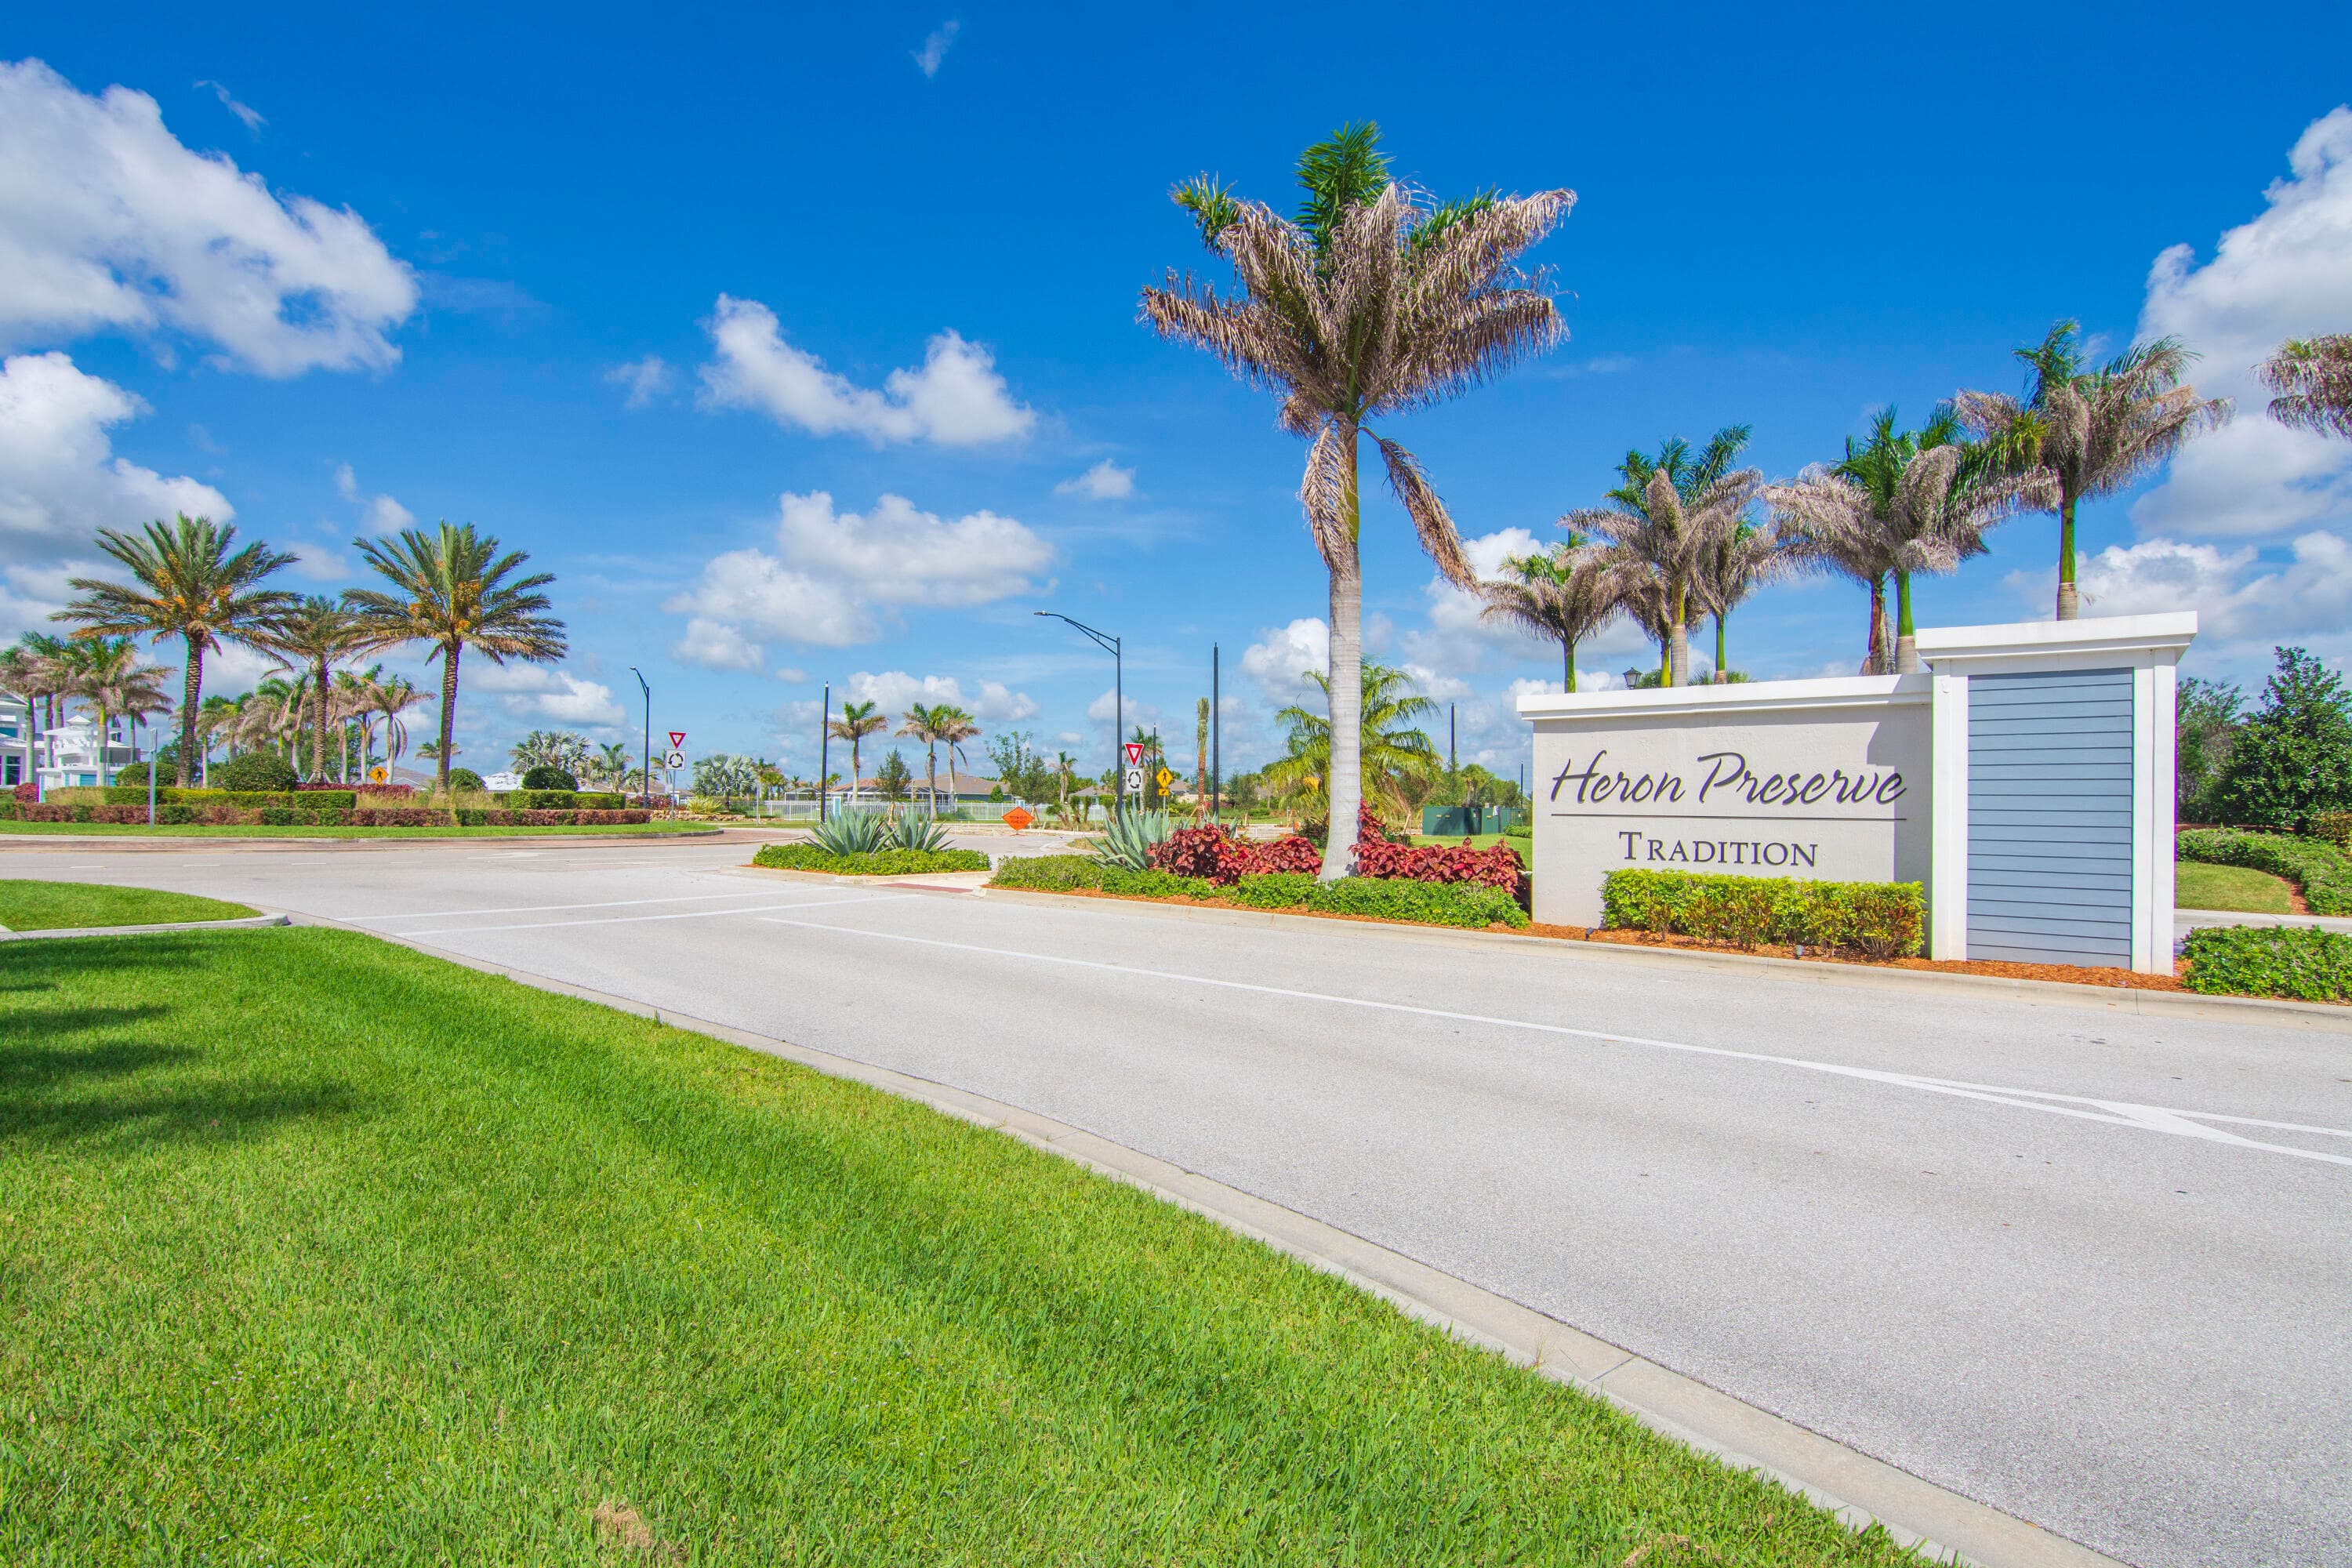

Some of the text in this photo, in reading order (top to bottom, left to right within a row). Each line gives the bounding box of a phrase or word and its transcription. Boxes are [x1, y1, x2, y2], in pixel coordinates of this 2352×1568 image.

[1550, 750, 1907, 805] Heron Preserve
[1619, 831, 1818, 867] TRADITION
